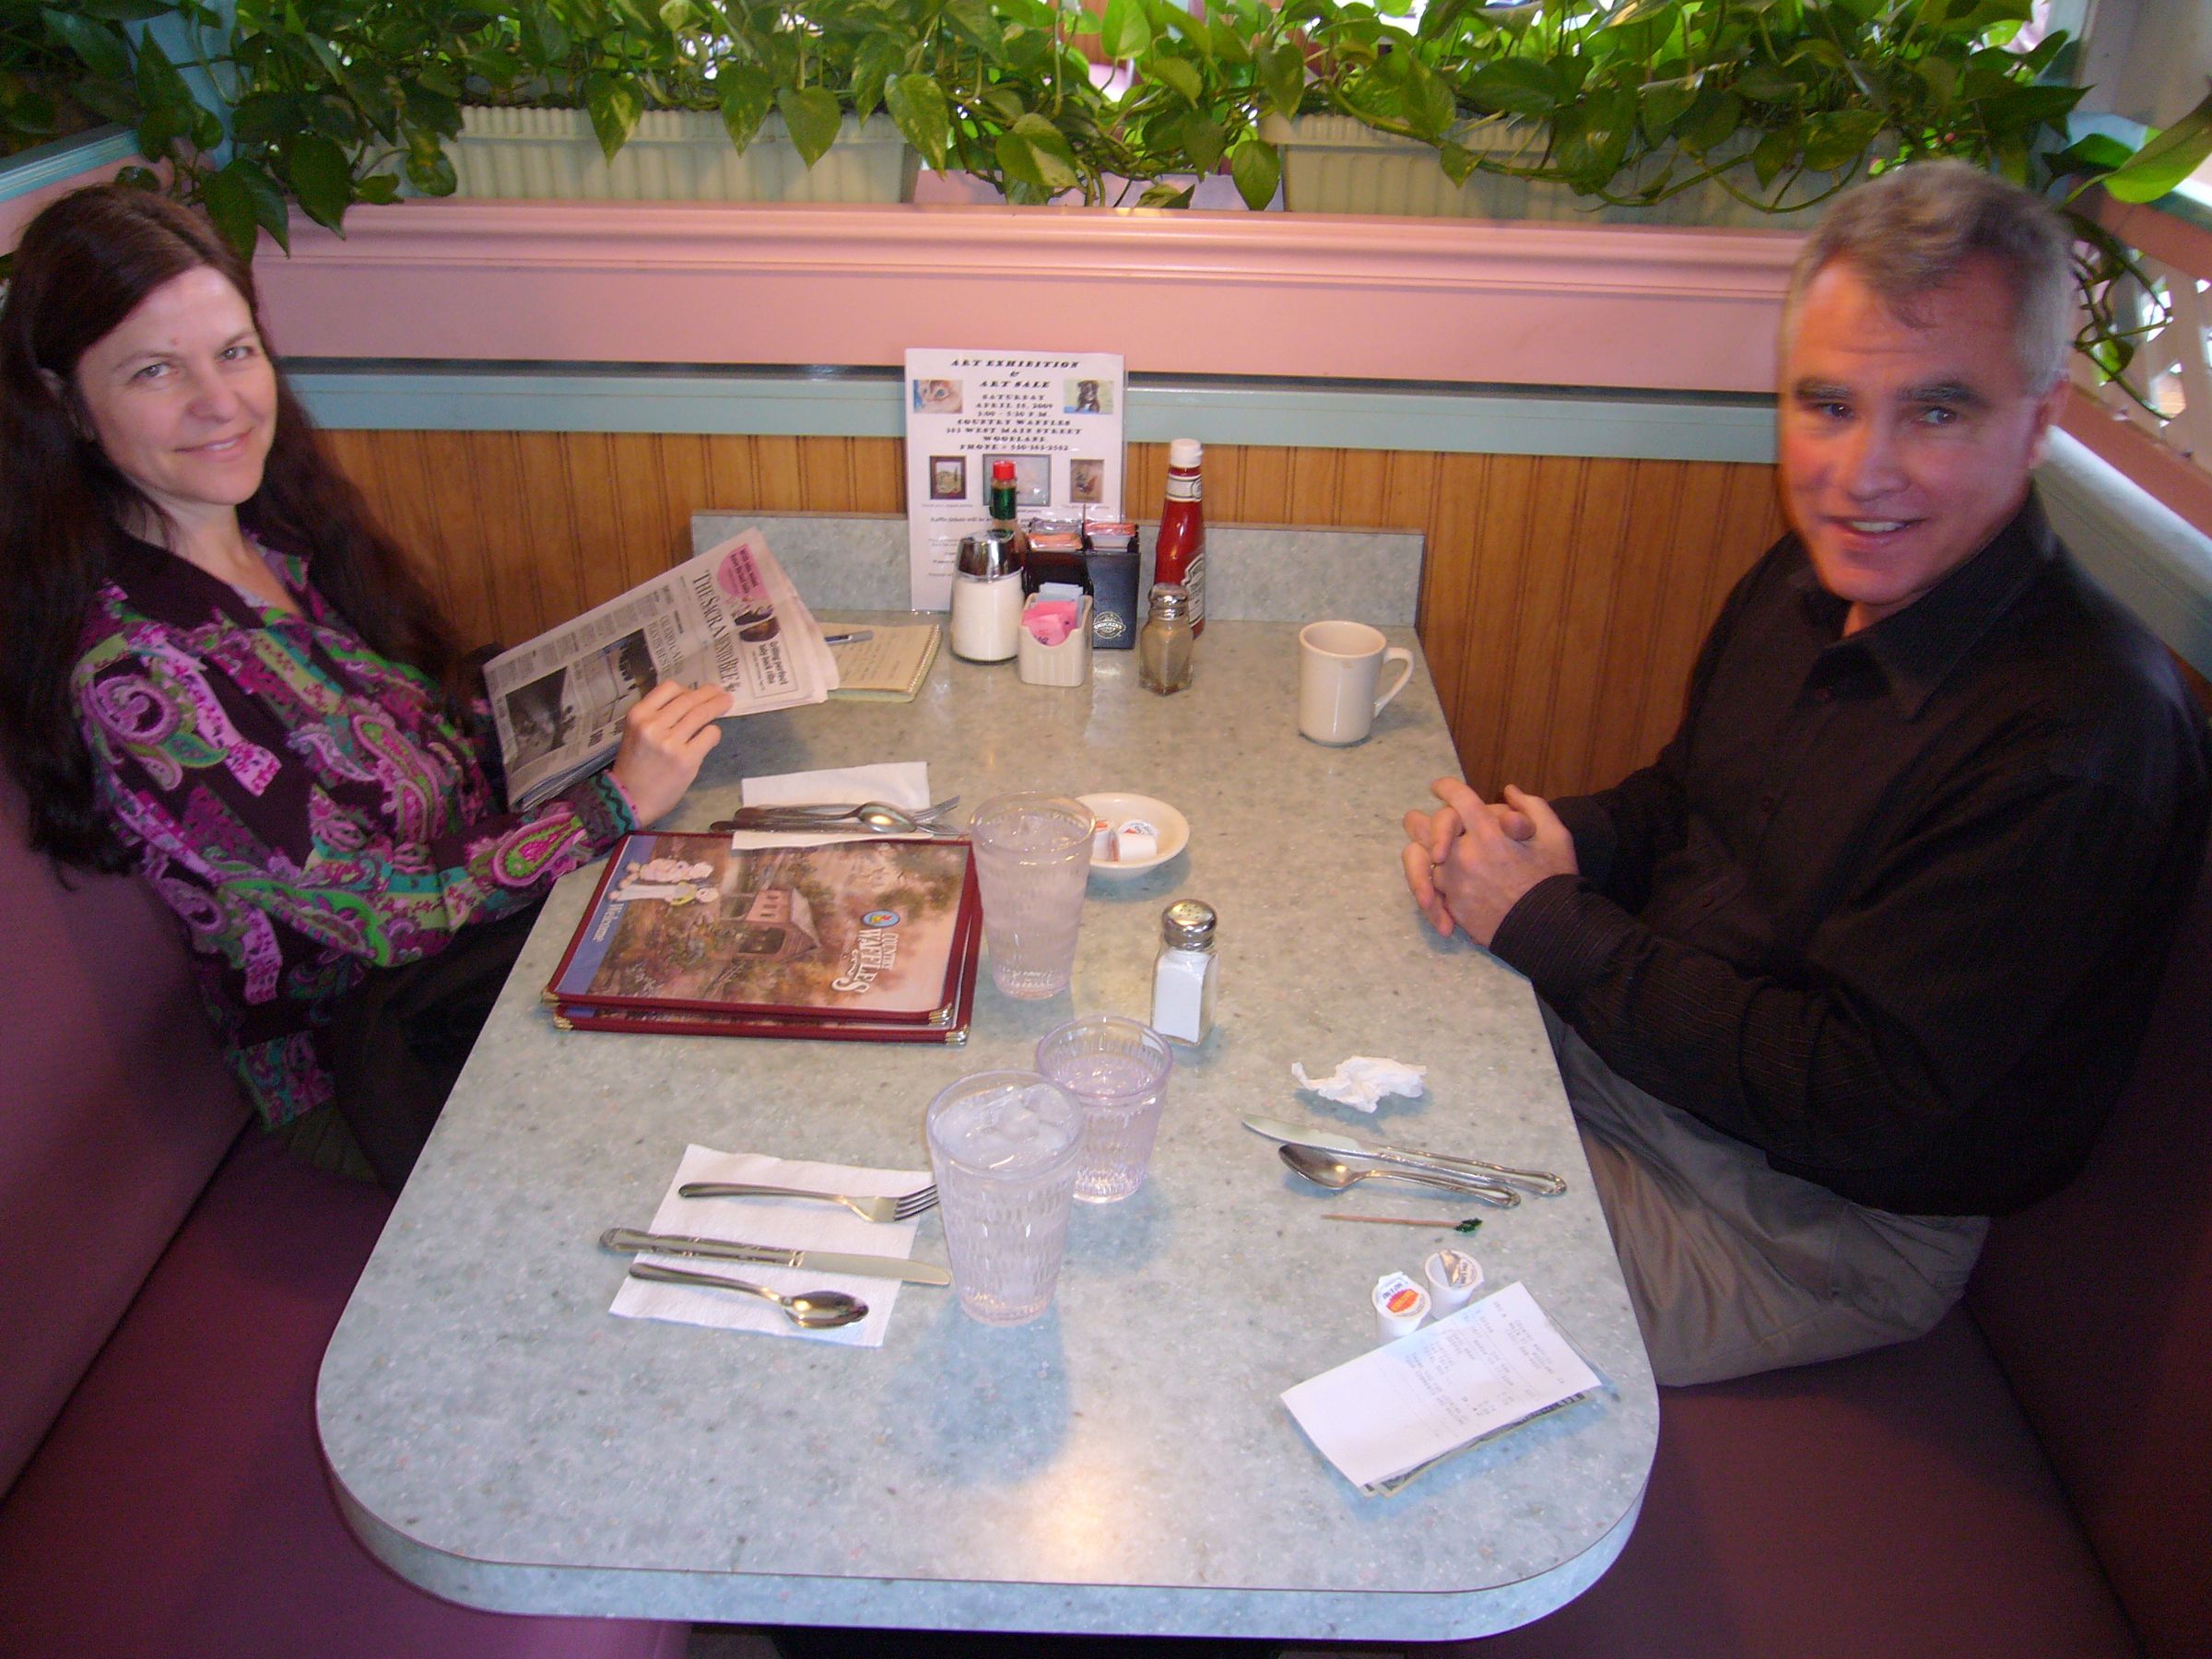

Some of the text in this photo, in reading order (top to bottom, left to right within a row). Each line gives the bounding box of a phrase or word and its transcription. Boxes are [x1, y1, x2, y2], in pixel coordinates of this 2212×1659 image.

[950, 359, 1079, 369] ART EXHIBITION
[831, 928, 883, 993] WAFFLES
[881, 933, 900, 971] COUNTRY
